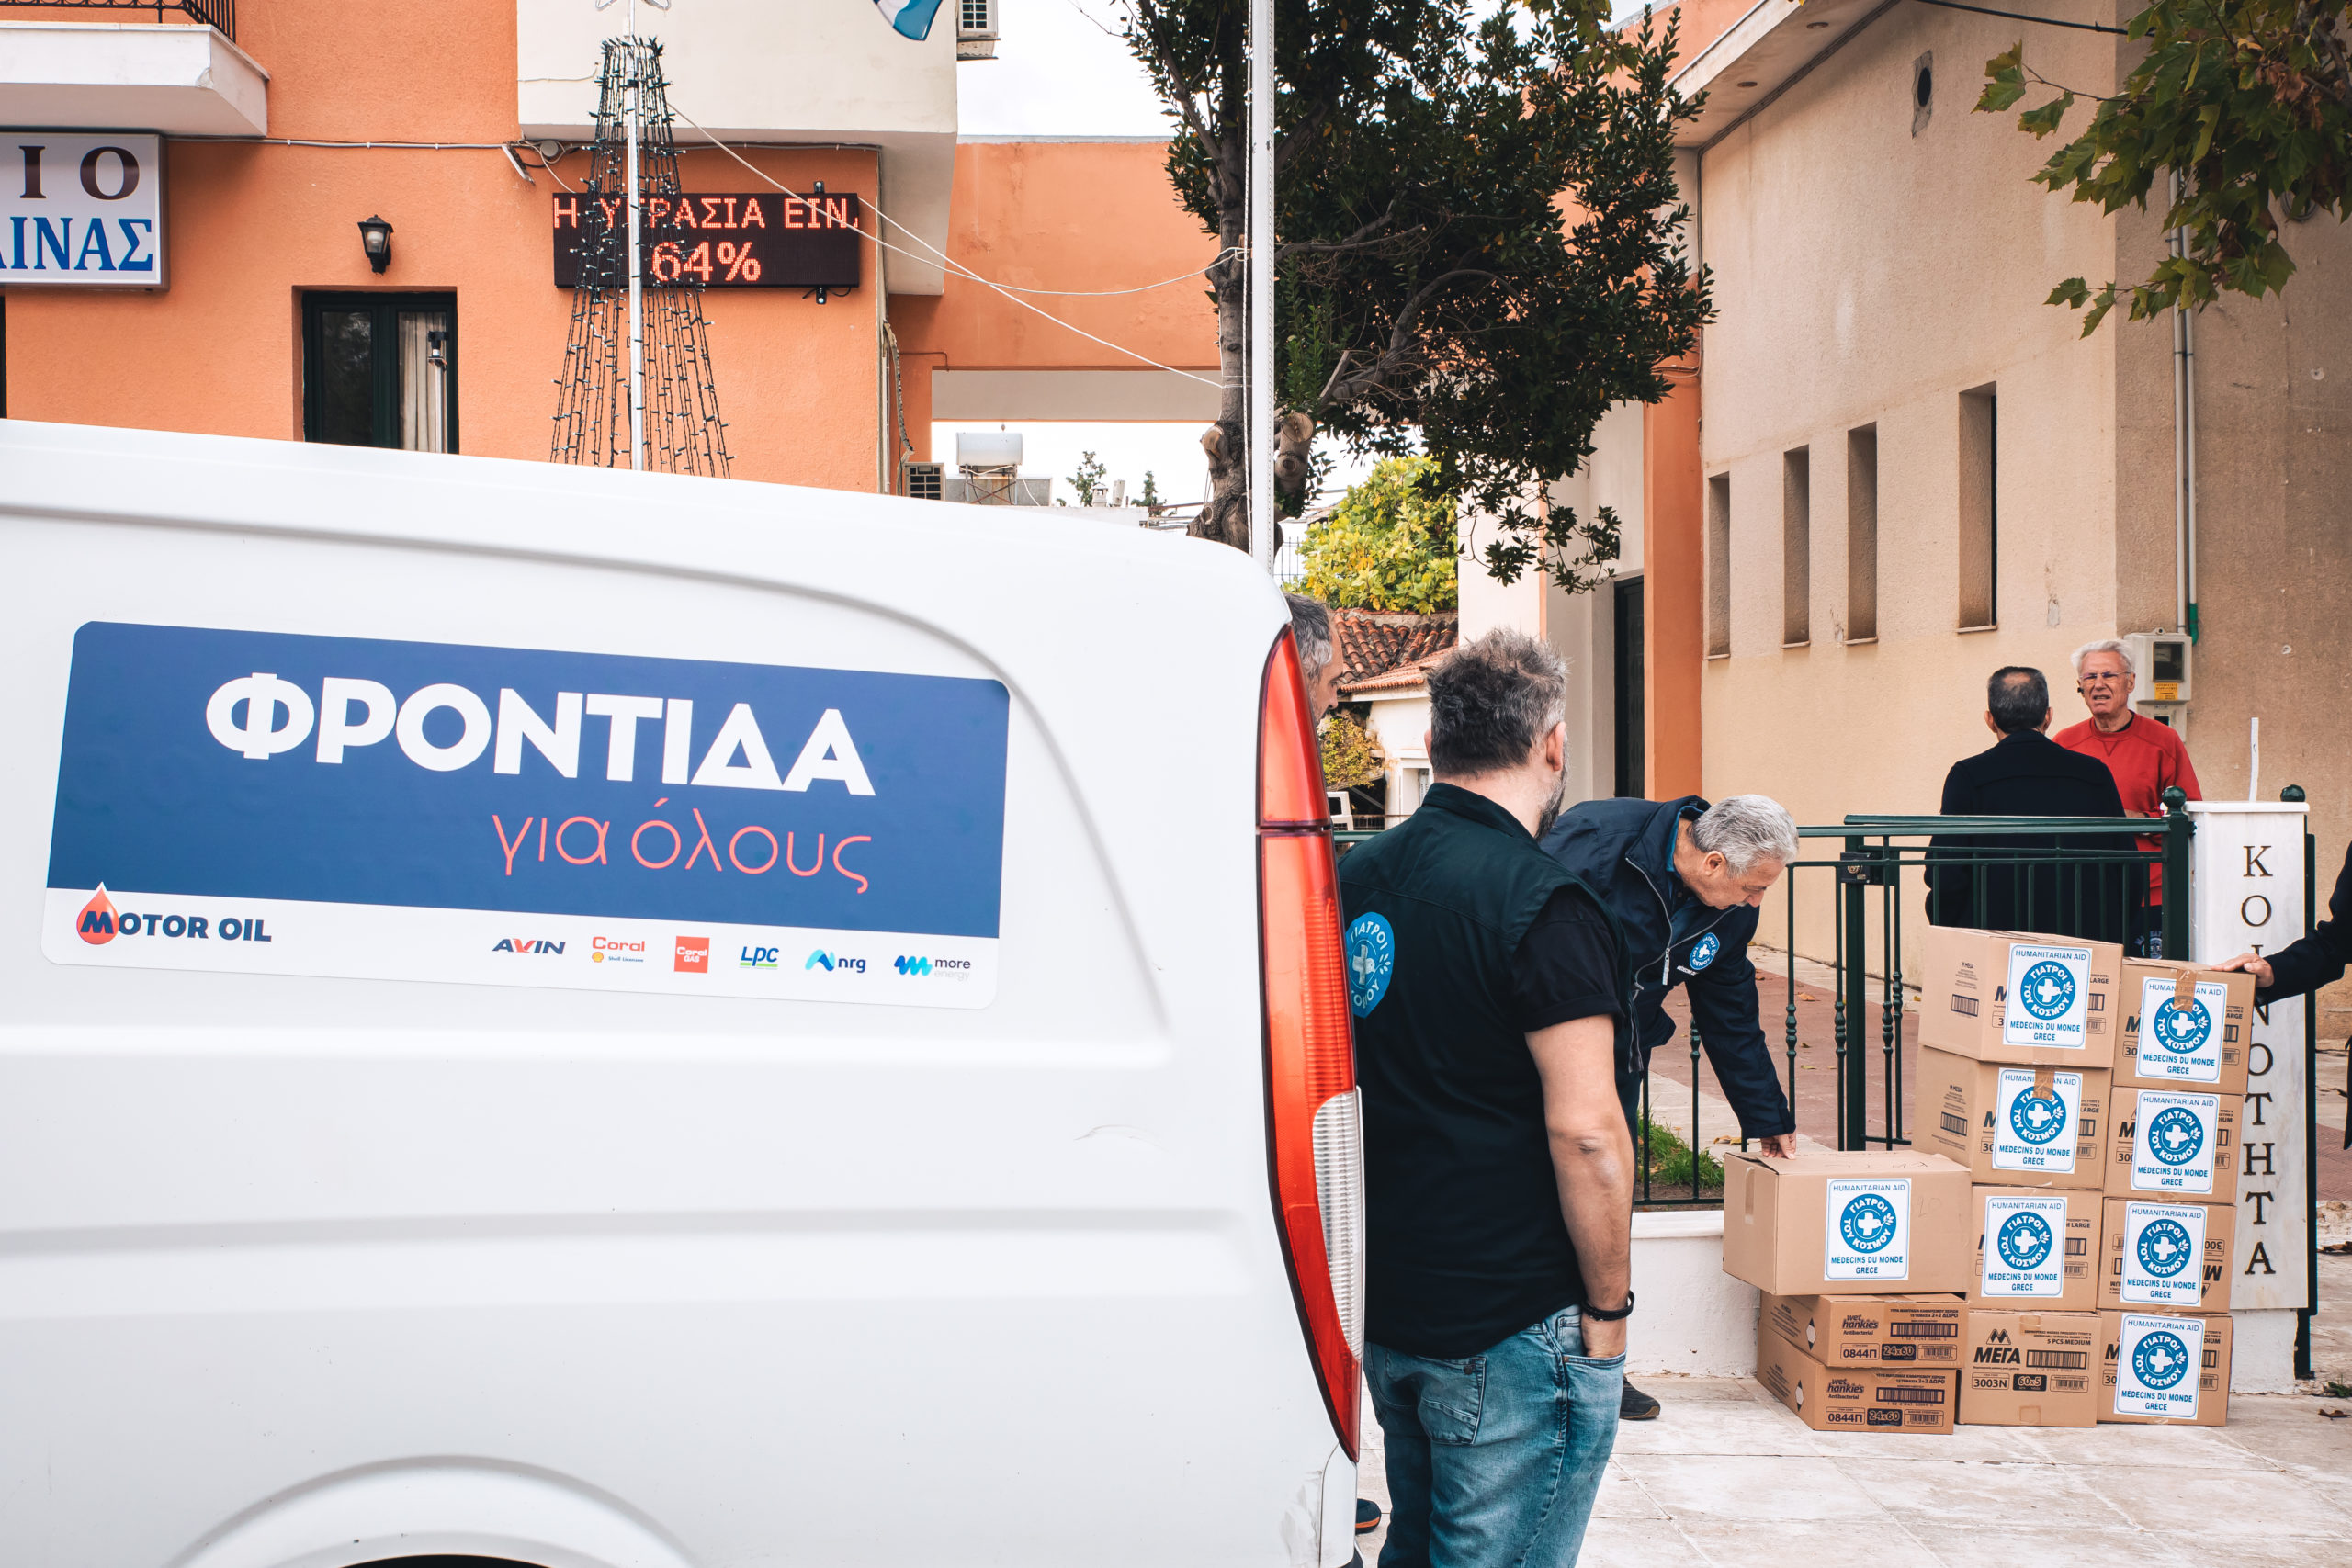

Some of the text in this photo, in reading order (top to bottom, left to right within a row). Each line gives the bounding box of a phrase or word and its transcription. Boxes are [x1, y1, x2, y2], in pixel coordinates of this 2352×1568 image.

[785, 197, 859, 229] ΕΙΝ
[651, 241, 762, 282] 64%
[205, 671, 876, 796] ΦΡΟΝΤΙΔΑ
[492, 797, 872, 895] για όλους
[79, 909, 273, 943] MOTOR OIL
[1351, 920, 1388, 950] ΓΙΑΤΡΟΙ
[492, 937, 567, 955] AVIN
[591, 936, 646, 953] Coral
[676, 946, 707, 957] Coral
[684, 955, 700, 964] GAS
[2016, 950, 2086, 961] HUMANITARIAN AID
[838, 957, 866, 974] nrg
[934, 958, 971, 970] more
[933, 971, 970, 982] energy
[2030, 964, 2068, 980] ΓΙΑΤΡΟΙ
[2023, 984, 2034, 1004] ΤΟΥ
[2031, 998, 2069, 1017] ΚΟΣΜΟΥ
[2165, 996, 2203, 1014] ΓΙΟΙ
[2056, 1023, 2080, 1032] MONDE
[2157, 1018, 2168, 1038] ΤΟΥ
[2165, 1031, 2205, 1051] ΚΟΣΜΟΥ
[2179, 1056, 2189, 1065] DU
[2191, 1058, 2215, 1066] MONDE
[2064, 1077, 2076, 1086] AID
[2143, 1097, 2199, 1106] HUMANITARIAN
[2014, 1109, 2025, 1130] ΤΟΥ
[2021, 1121, 2061, 1141] ΚΟΣΜΟΥ
[2158, 1111, 2196, 1127] ΓΙΑΤΡΟΙ
[2035, 1146, 2044, 1156] DU
[2047, 1148, 2071, 1156] MONDE
[2152, 1130, 2161, 1150] ΤΟΥ
[2159, 1143, 2198, 1163] ΚΟΣΜΟΥ
[2185, 1169, 2208, 1178] MONDE
[1849, 1198, 1888, 1213] ΓΙΑΤΡΟΙ
[2132, 1209, 2188, 1218] HUMANITARIAN
[2007, 1216, 2045, 1231] ΓΙΑΤΡΟΙ
[1843, 1218, 1891, 1250] ΤΟΥ ΚΟΣΜΟΥ
[2146, 1224, 2184, 1238] ΓΙΑΤΡΟΙ
[2001, 1235, 2011, 1256] ΤΟΥ
[2008, 1247, 2047, 1267] ΚΟΣΜΟΥ
[2141, 1242, 2150, 1262] ΤΟΥ
[2148, 1255, 2186, 1274] ΚΟΣΜΟΥ
[1880, 1256, 1904, 1264] MONDE
[2173, 1281, 2196, 1290] MONDE
[1842, 1319, 1879, 1329] hankies
[2128, 1319, 2185, 1330] HUMANITARIAN
[2143, 1336, 2181, 1350] ΓΙΑΤΡΟΙ
[1883, 1346, 1914, 1356] 24x60
[1973, 1347, 2021, 1364] ΜΕΓΑ
[2135, 1354, 2183, 1387] ΤΟΥ ΚΟΣΜΟΥ
[1826, 1383, 1865, 1393] hankies
[1973, 1378, 2007, 1388] 3003N
[2018, 1376, 2041, 1386] 60x5
[1869, 1410, 1900, 1421] 24x60
